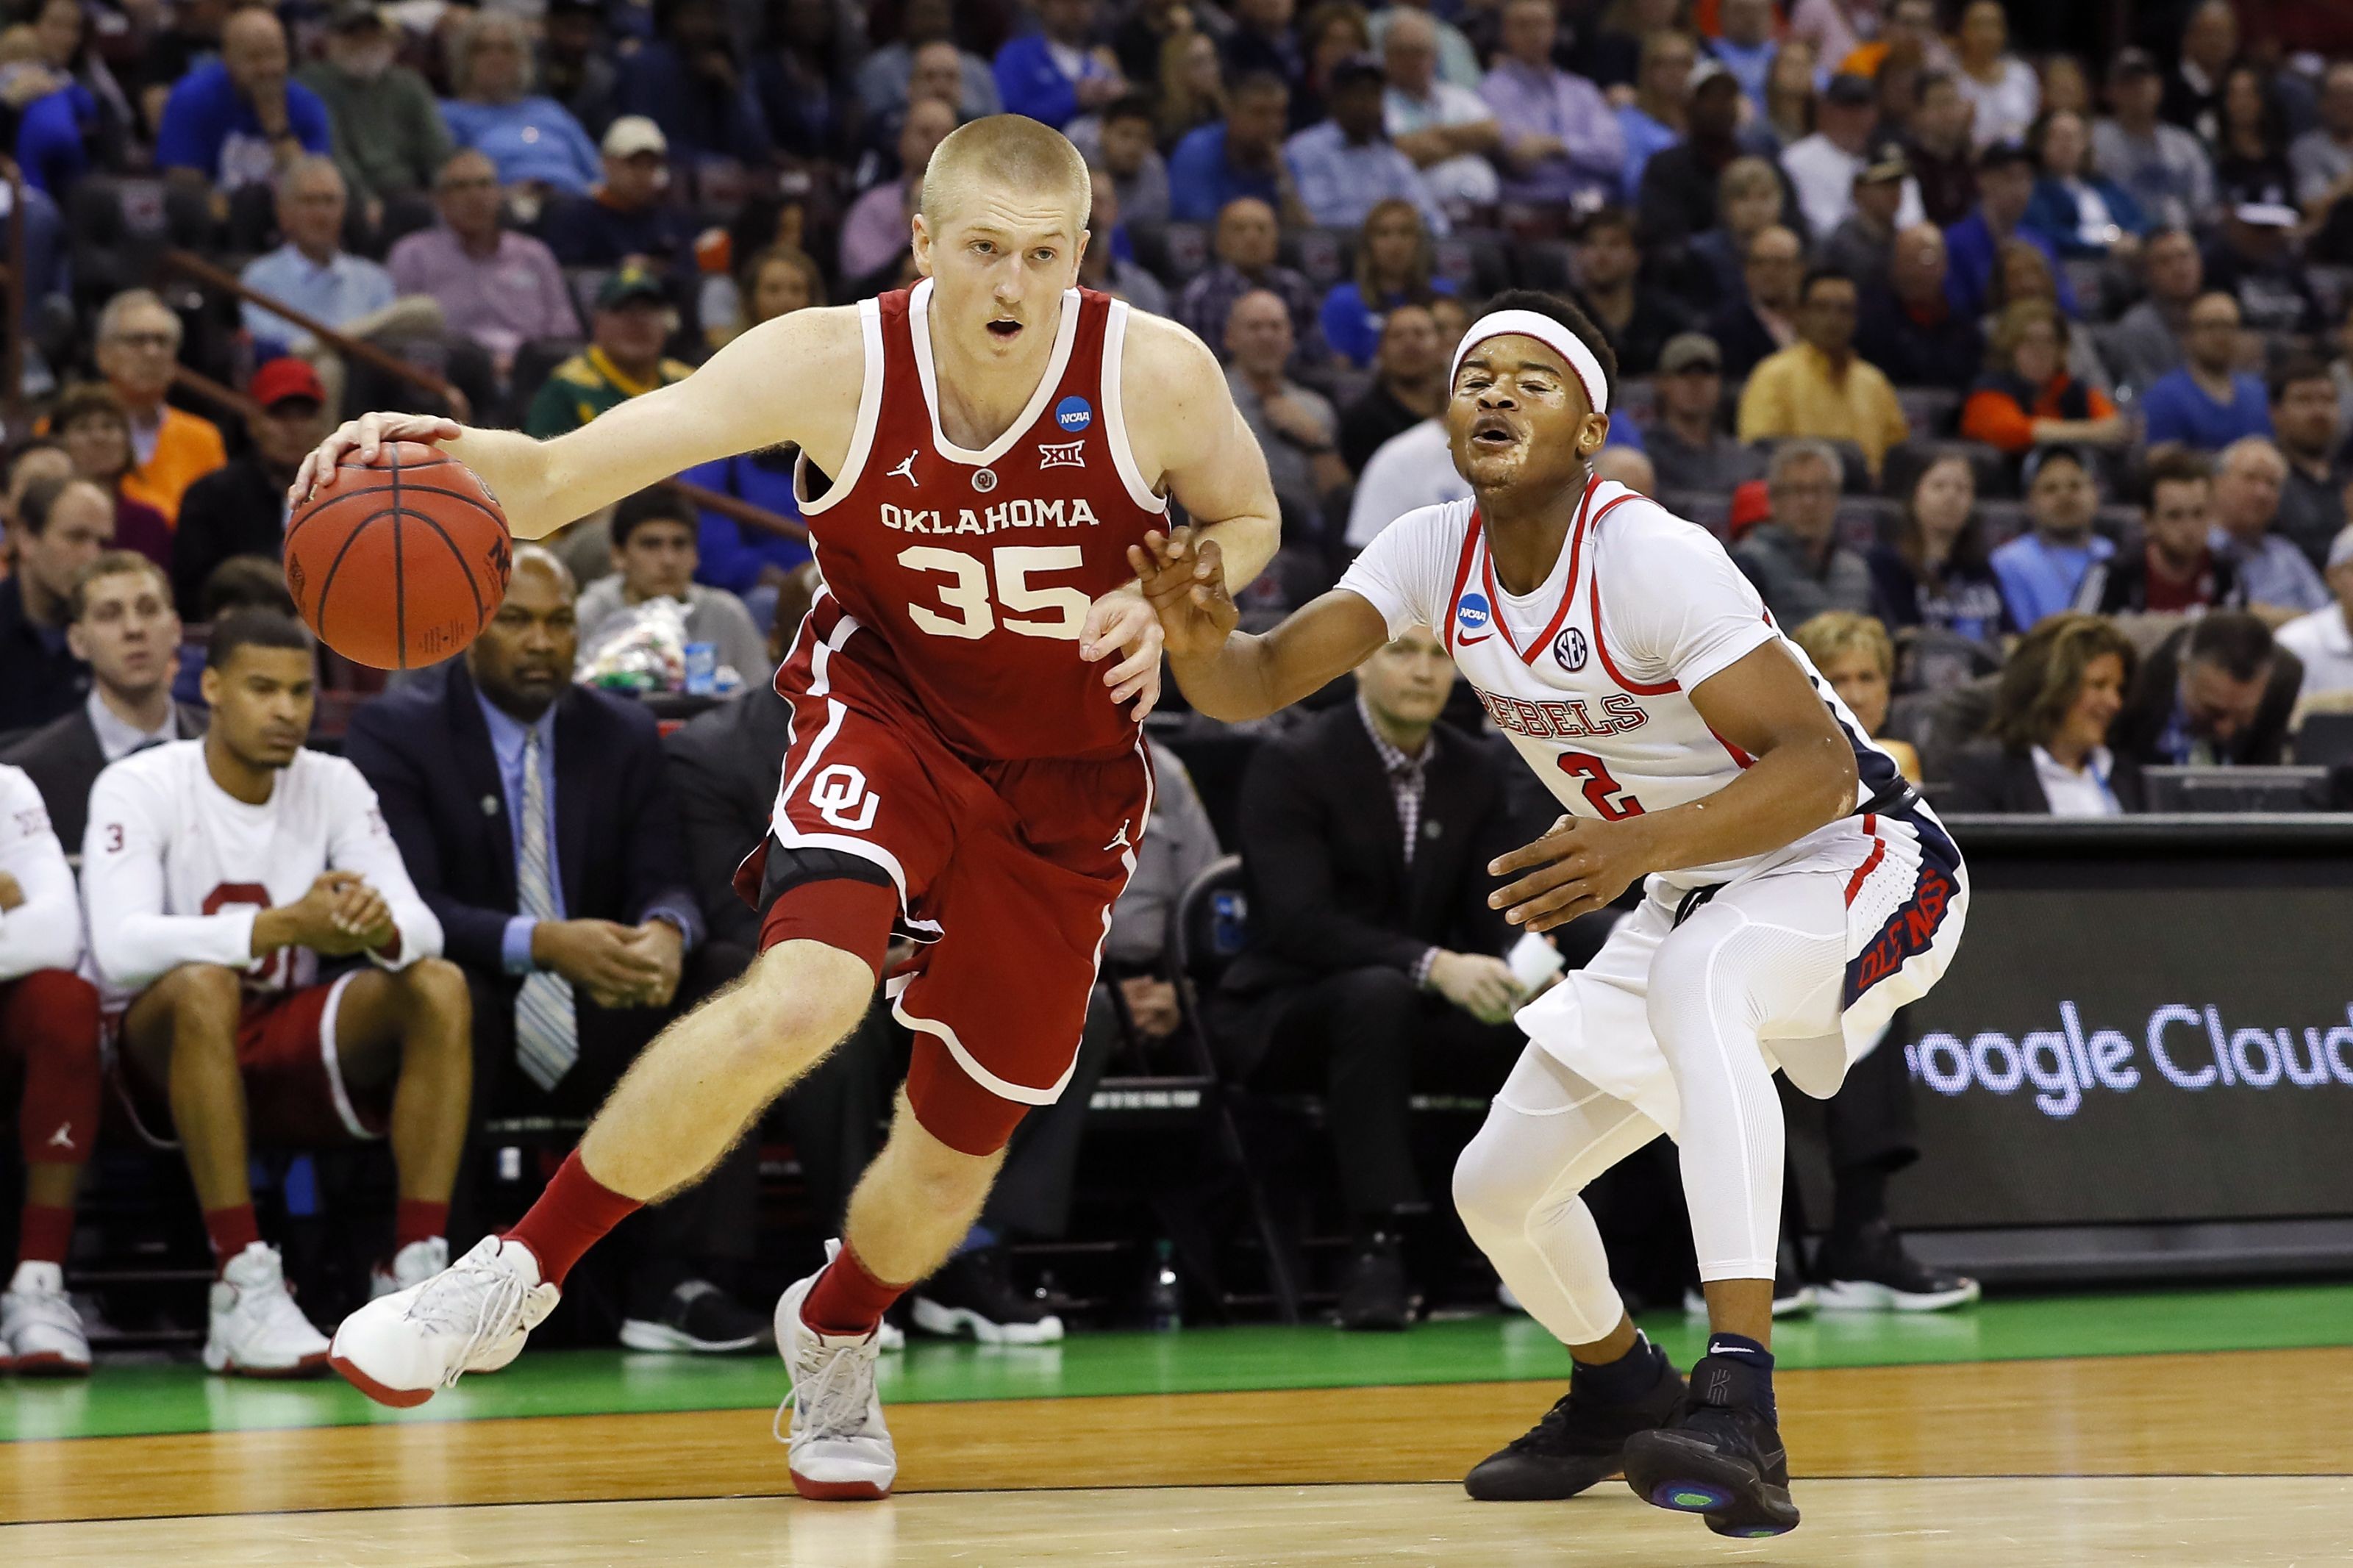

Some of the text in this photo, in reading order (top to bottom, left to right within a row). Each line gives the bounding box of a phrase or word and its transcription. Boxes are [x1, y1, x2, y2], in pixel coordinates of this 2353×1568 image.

[1060, 412, 1090, 424] NCAA
[880, 498, 1100, 536] OKLAHOMA
[896, 545, 1092, 640] 35
[1460, 606, 1487, 622] NCAA
[1556, 629, 1587, 670] SEC
[808, 763, 881, 831] OU
[1557, 751, 1646, 822] 2
[107, 823, 124, 853] 3
[1904, 1000, 2141, 1117] oogle
